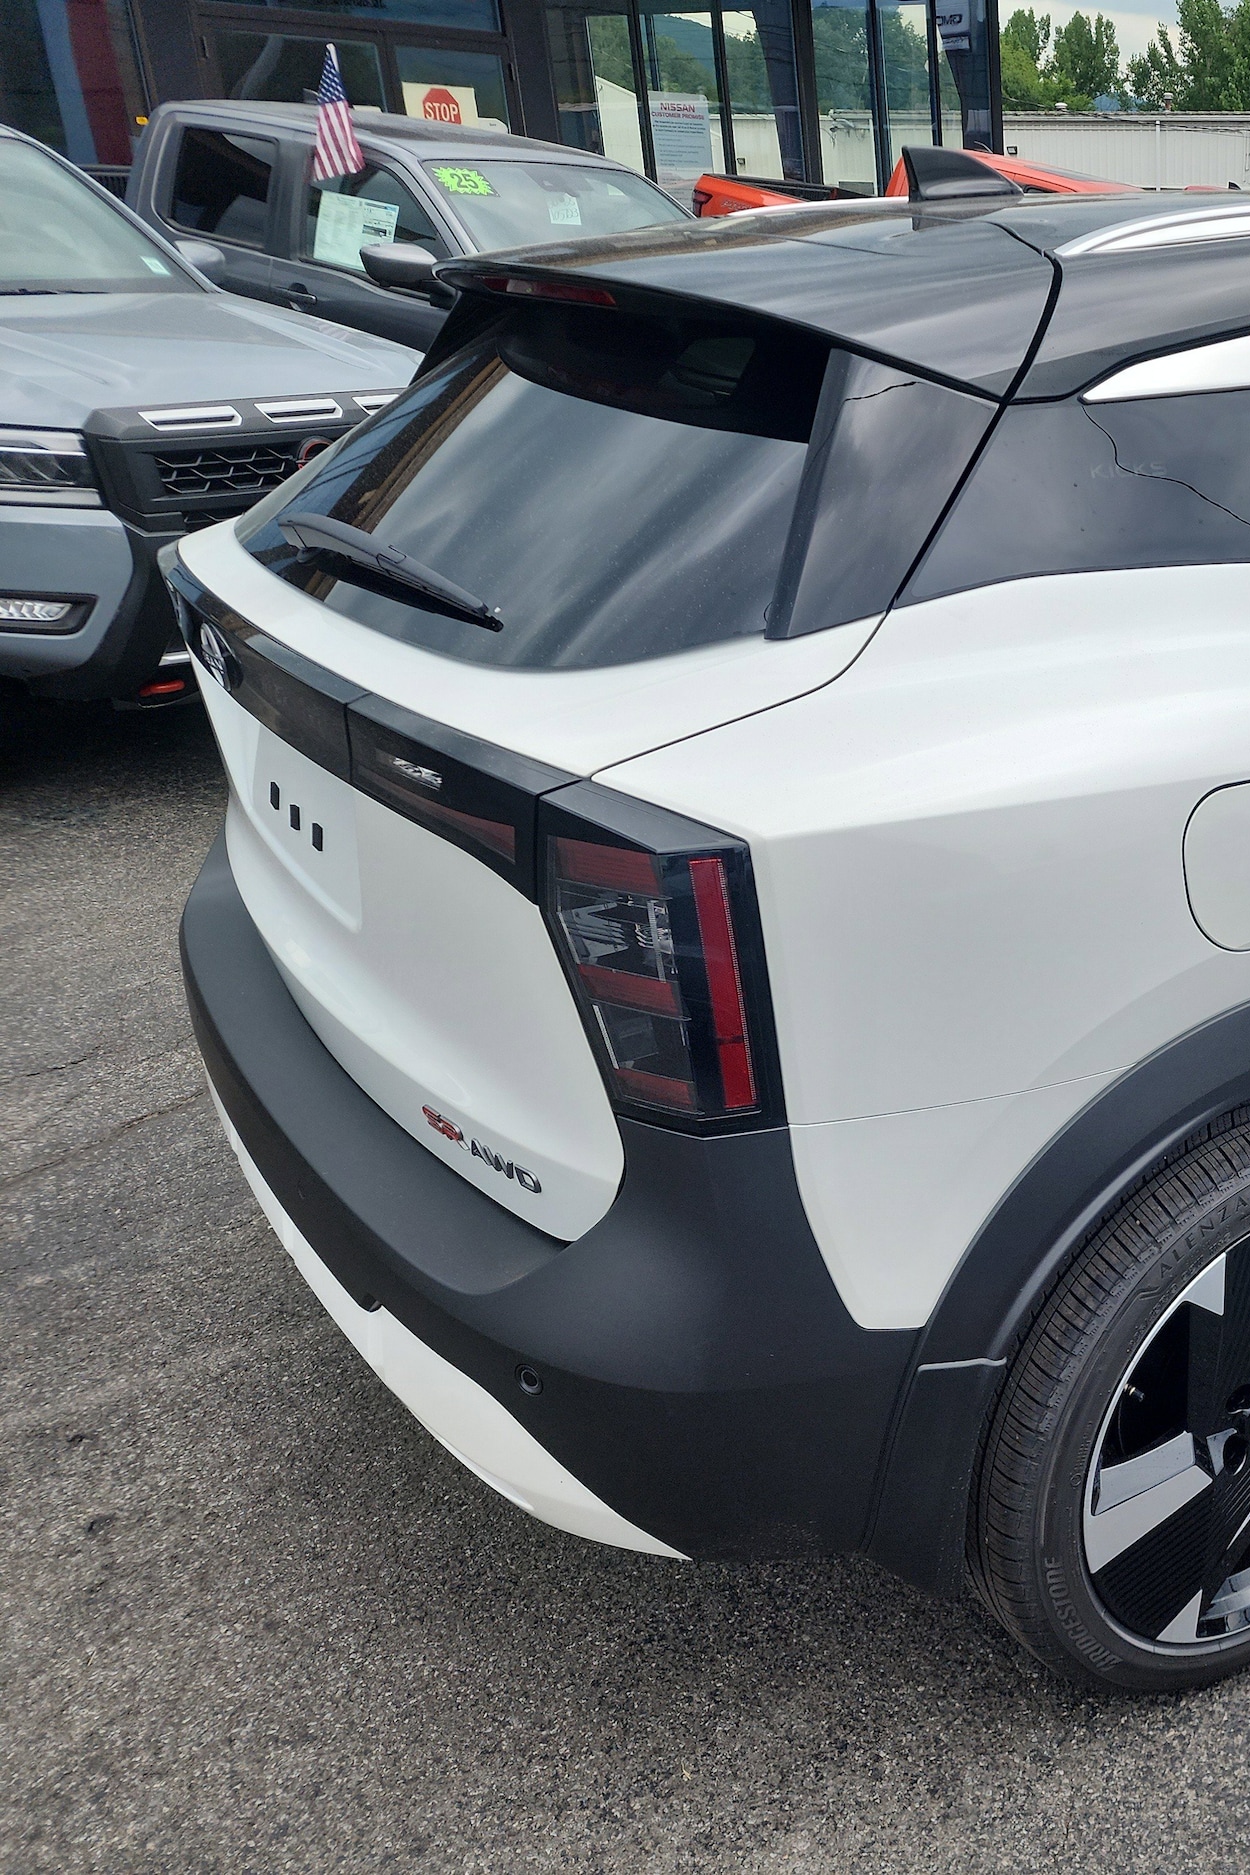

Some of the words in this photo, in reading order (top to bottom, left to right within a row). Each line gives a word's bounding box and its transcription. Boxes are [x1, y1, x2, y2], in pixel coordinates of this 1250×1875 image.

[424, 101, 459, 123] STOP
[660, 103, 696, 113] NISSAN
[450, 172, 479, 190] 25
[421, 1104, 470, 1151] SR
[470, 1137, 543, 1194] AWD
[1044, 1556, 1122, 1672] BRIDGESTONE
